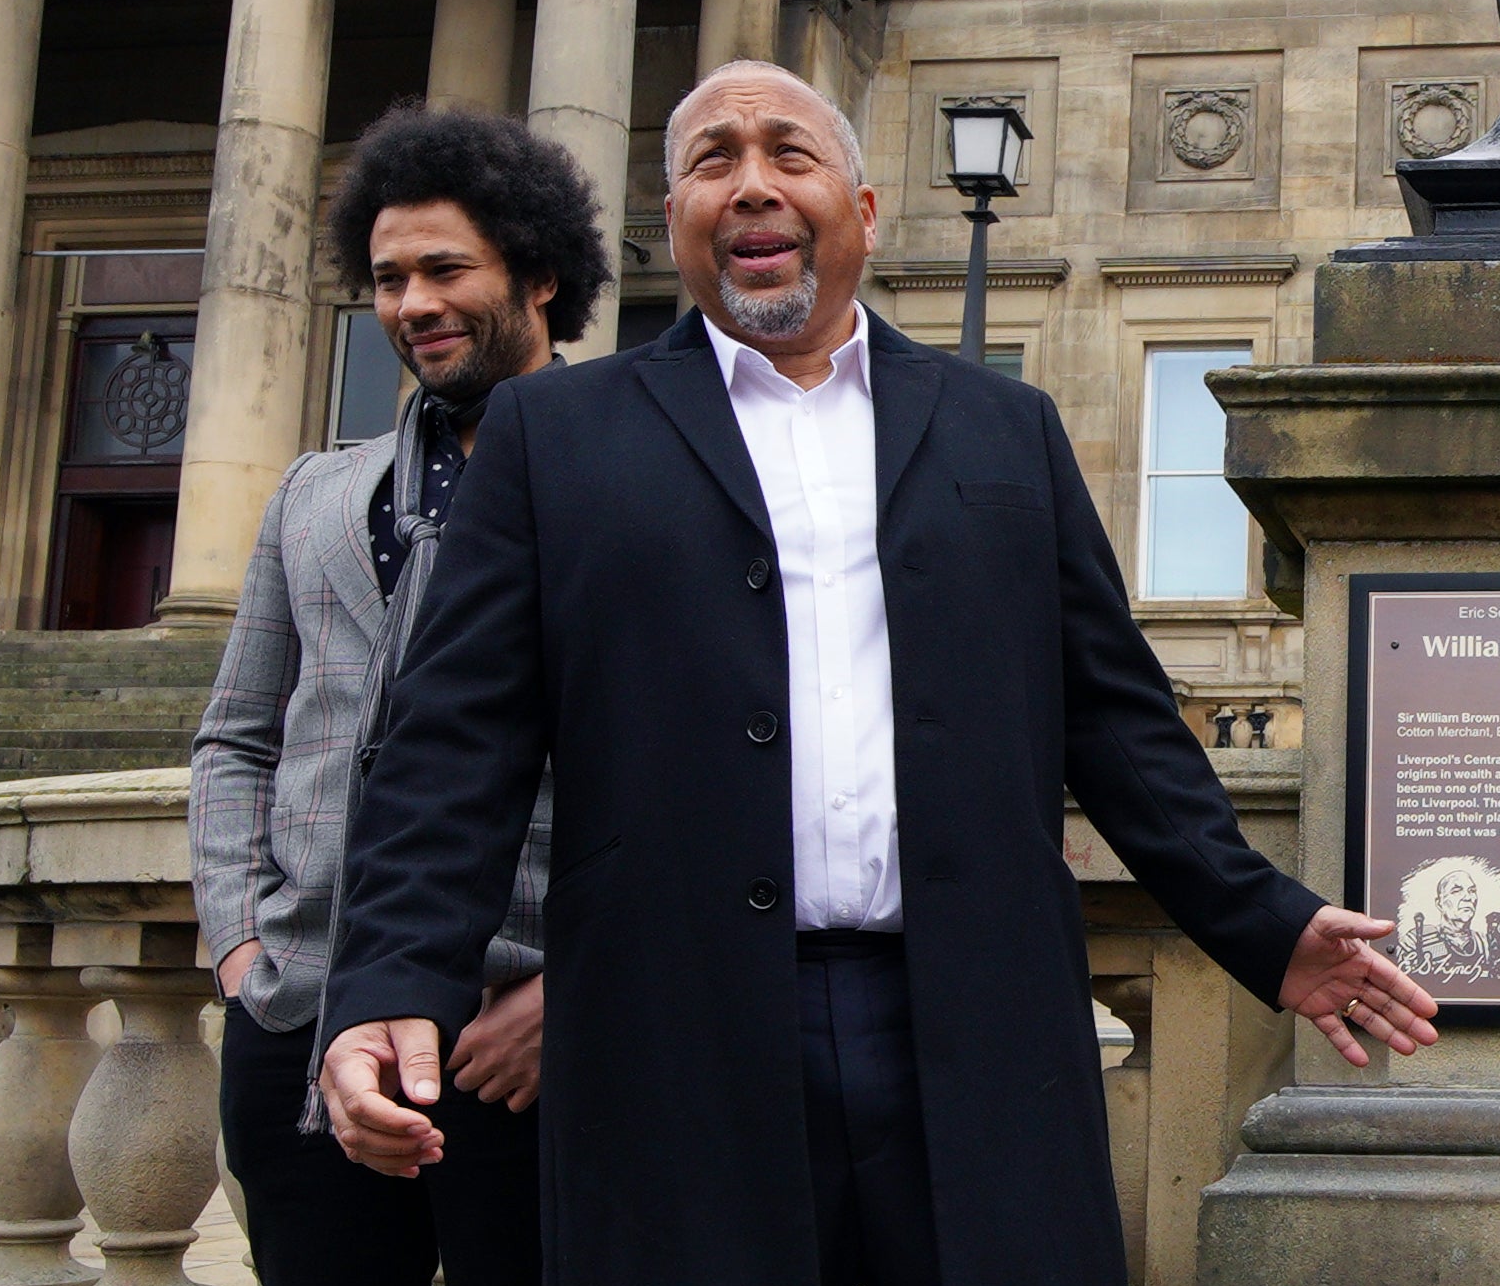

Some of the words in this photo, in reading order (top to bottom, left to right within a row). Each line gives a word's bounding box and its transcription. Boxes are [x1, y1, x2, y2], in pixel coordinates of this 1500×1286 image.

[1459, 607, 1485, 618] Eric
[1398, 713, 1414, 723] Sir
[1417, 713, 1458, 723] William
[1462, 713, 1499, 723] Brown
[1397, 726, 1434, 737] Cotton
[1438, 727, 1493, 738] Merchant,
[1398, 755, 1460, 767] Liverpool's
[1397, 769, 1437, 781] origins
[1441, 769, 1451, 779] in
[1454, 769, 1492, 779] wealth
[1397, 783, 1442, 793] became
[1445, 785, 1466, 793] one
[1470, 783, 1482, 793] of
[1397, 798, 1419, 807] into
[1422, 798, 1479, 810] Liverpool.
[1397, 812, 1435, 824] people
[1438, 814, 1453, 822] on
[1457, 812, 1483, 822] their
[1396, 827, 1433, 836] Brown
[1436, 827, 1471, 836] Street
[1474, 829, 1496, 837] was
